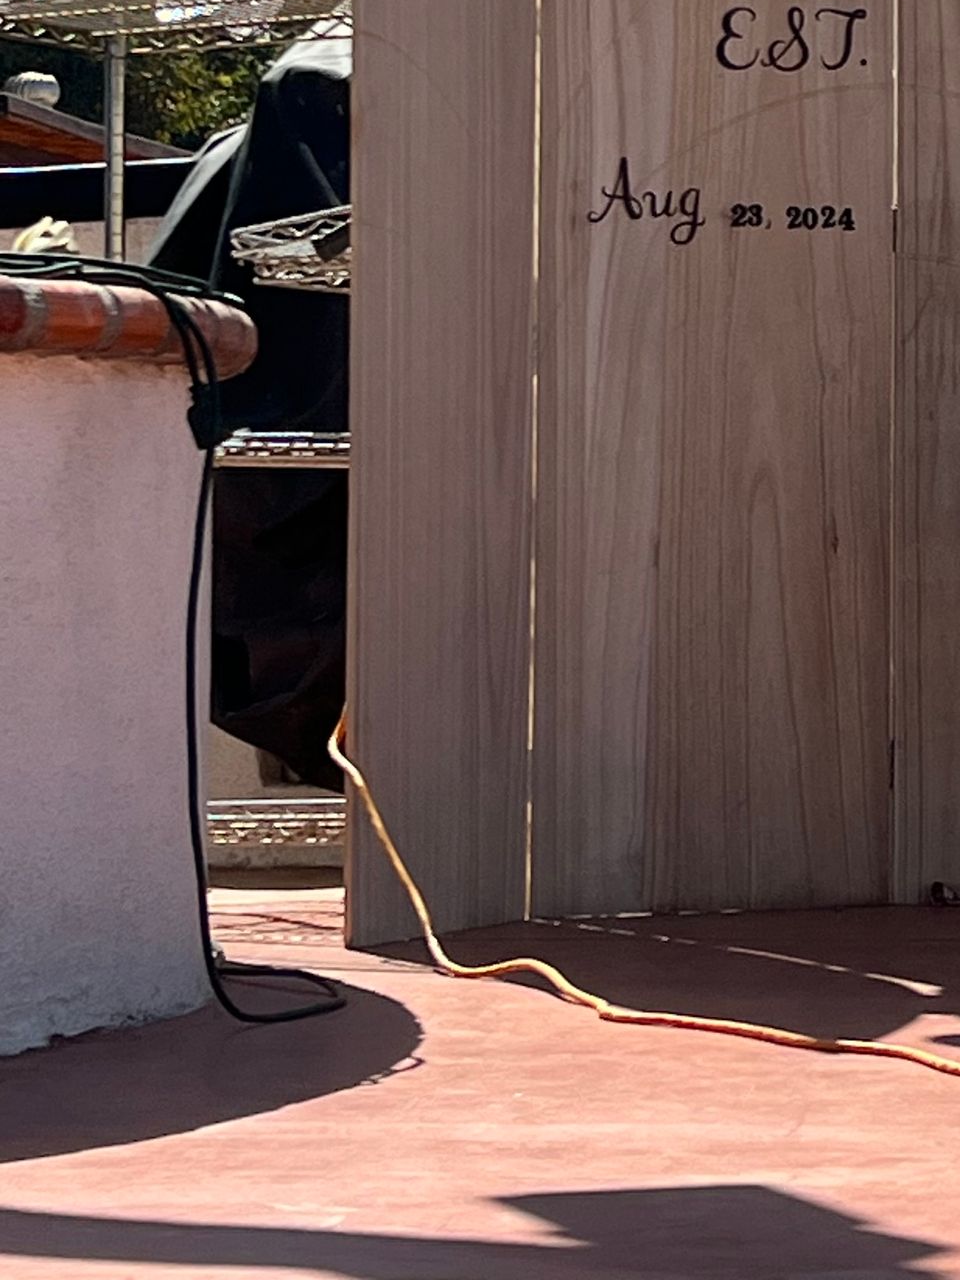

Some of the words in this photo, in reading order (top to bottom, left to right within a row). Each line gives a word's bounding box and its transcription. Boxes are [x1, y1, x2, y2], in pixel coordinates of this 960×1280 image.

[715, 6, 868, 73] EST.
[586, 156, 706, 246] Aug
[785, 205, 856, 232] 2024
